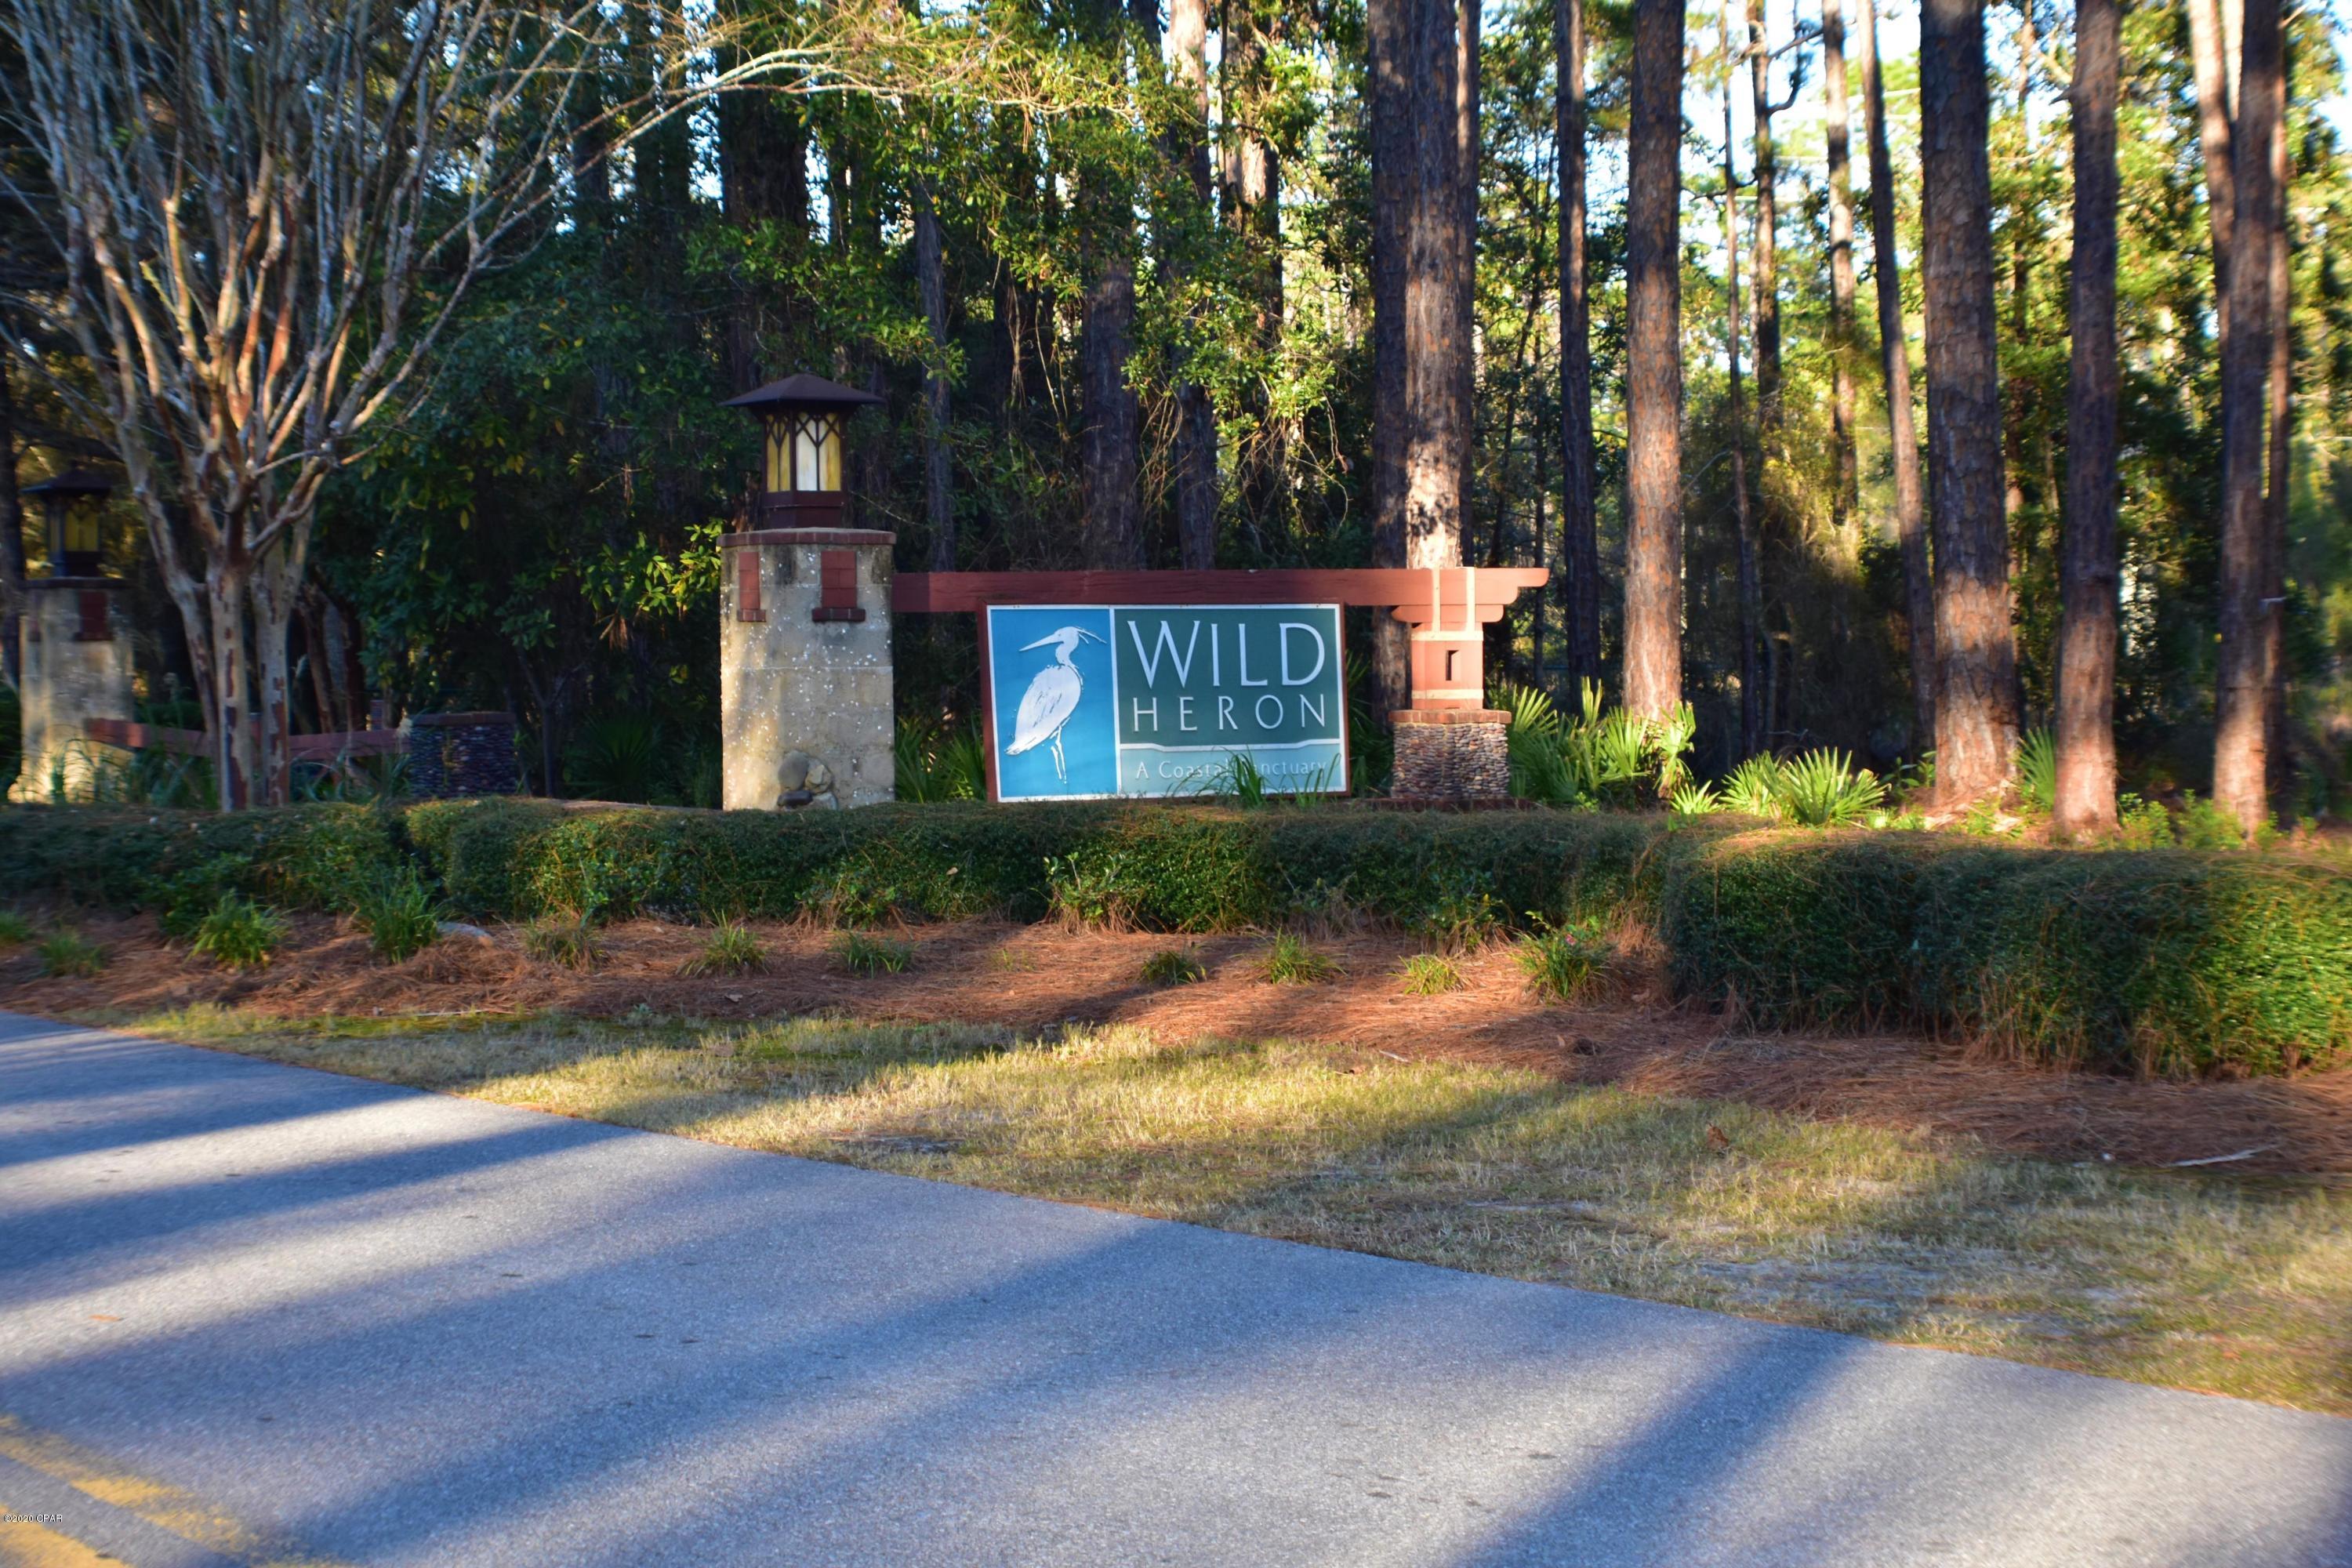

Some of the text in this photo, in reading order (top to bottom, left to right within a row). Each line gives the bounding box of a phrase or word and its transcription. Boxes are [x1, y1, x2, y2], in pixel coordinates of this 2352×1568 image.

[1127, 620, 1326, 688] WILD
[1132, 694, 1326, 731] HERON
[1135, 757, 1327, 779] A Coastal nctuary
